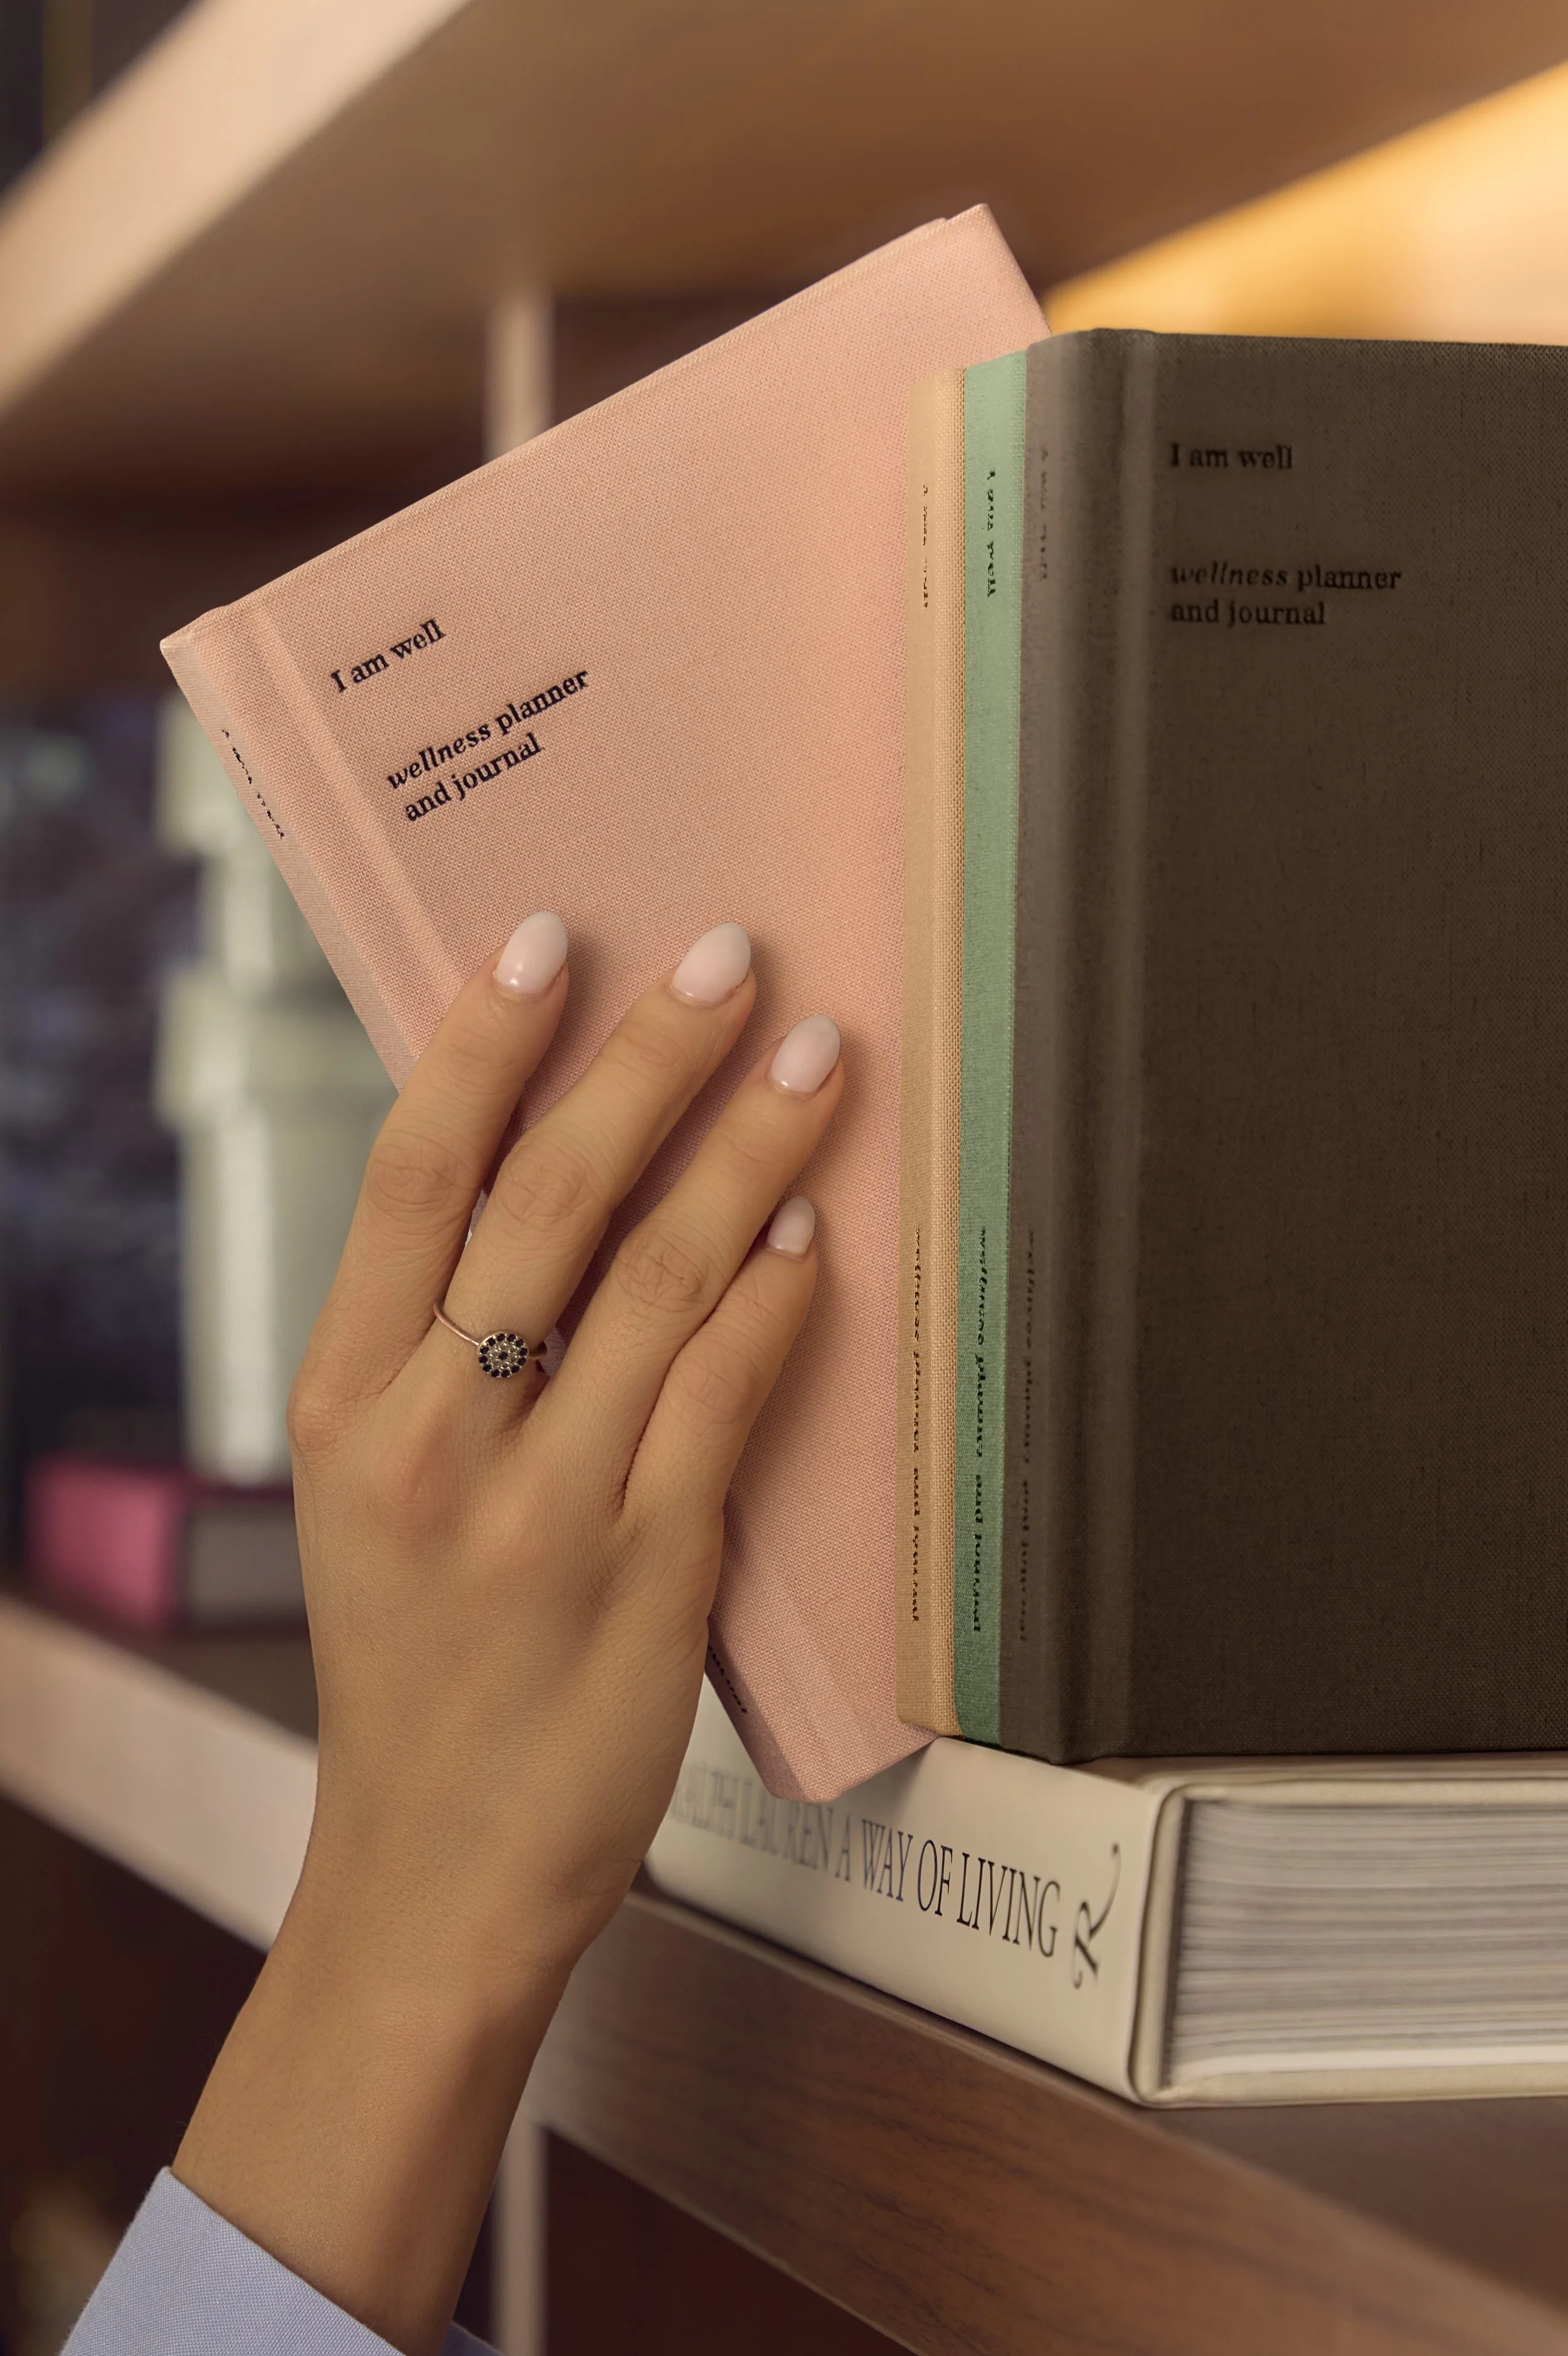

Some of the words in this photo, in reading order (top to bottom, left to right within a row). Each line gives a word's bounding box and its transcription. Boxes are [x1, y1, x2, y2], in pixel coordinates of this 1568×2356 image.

[1170, 442, 1180, 467] I
[1189, 447, 1229, 469] am
[1237, 444, 1293, 470] well
[1170, 561, 1288, 587] wellness
[1296, 563, 1402, 592] planner
[1170, 598, 1219, 623] and
[1227, 600, 1326, 628] journal
[331, 670, 347, 692] I
[351, 654, 389, 684] am
[389, 617, 447, 659] well
[386, 723, 491, 789] wellness
[495, 671, 588, 735] planner
[406, 782, 452, 822] and
[451, 732, 545, 801] journal
[835, 1813, 851, 1882] A
[862, 1819, 914, 1902] WAY
[917, 1839, 953, 1916] OF
[956, 1852, 1061, 1958] LIVING
